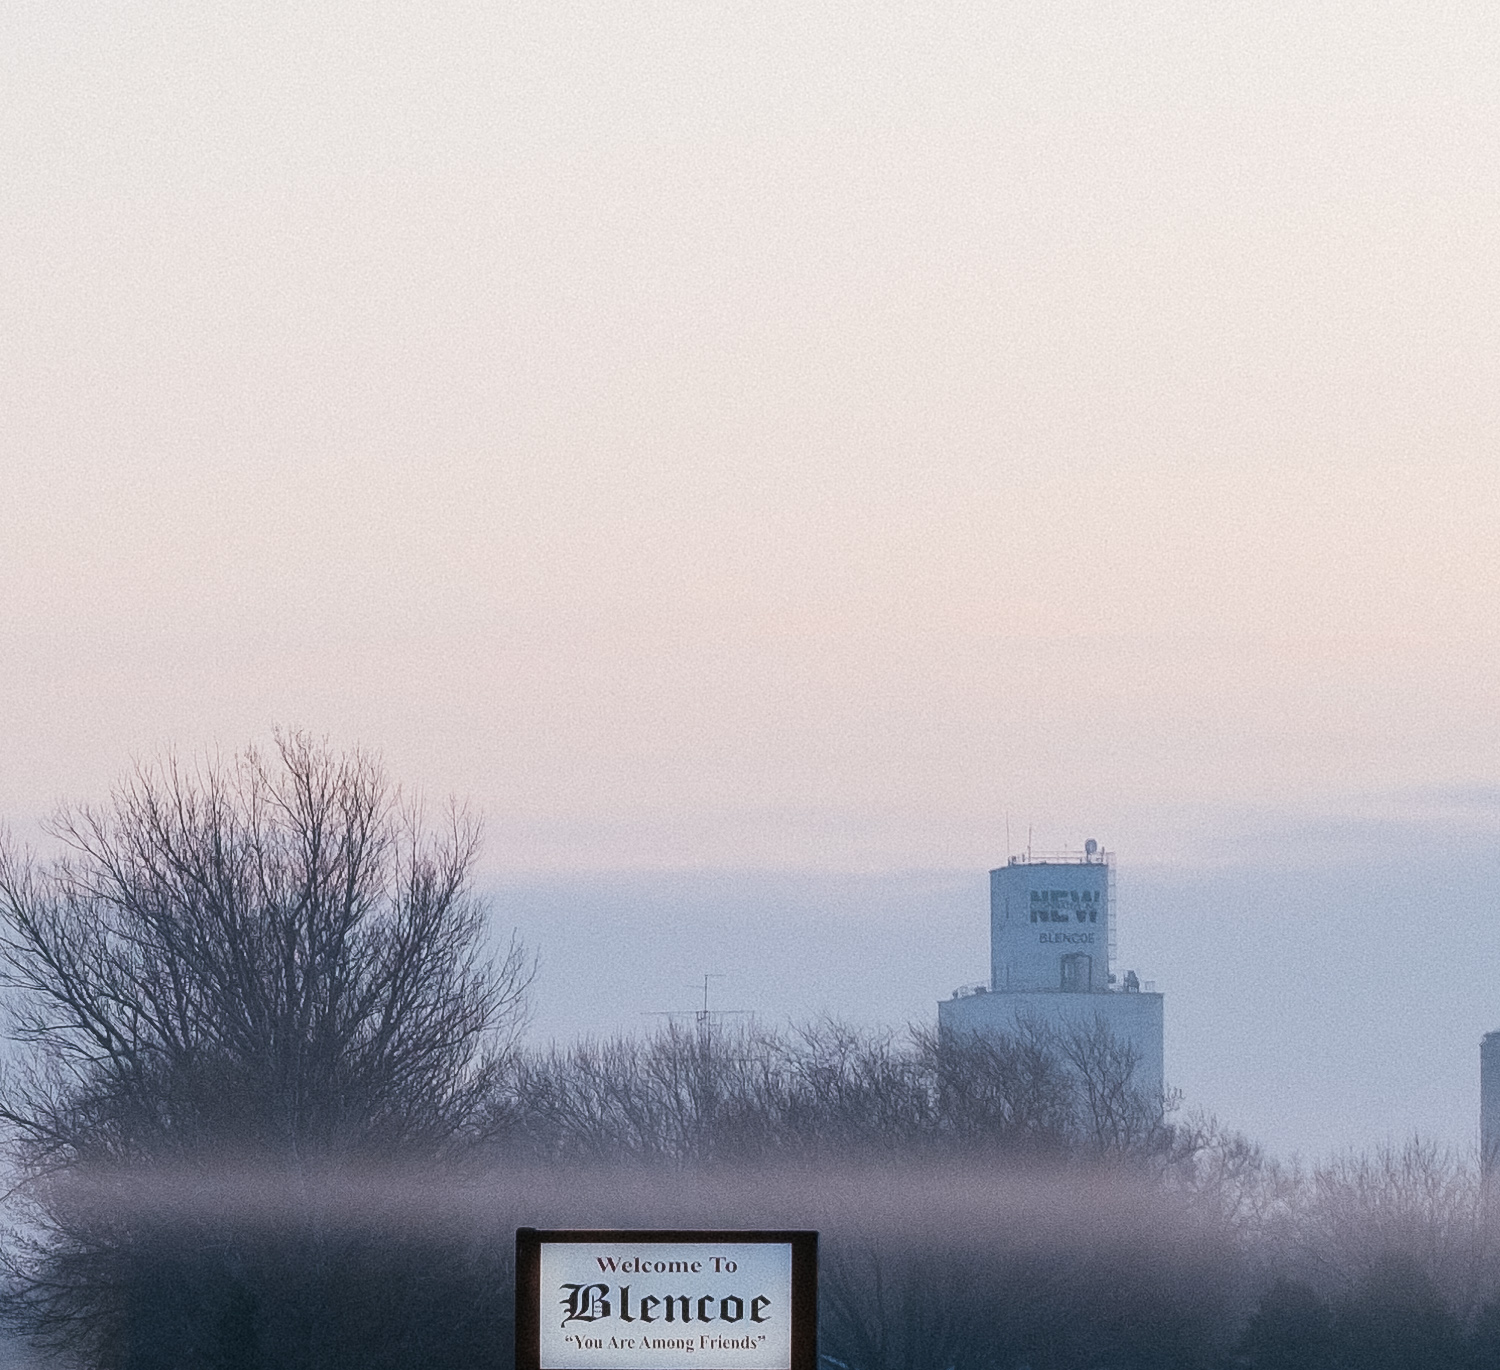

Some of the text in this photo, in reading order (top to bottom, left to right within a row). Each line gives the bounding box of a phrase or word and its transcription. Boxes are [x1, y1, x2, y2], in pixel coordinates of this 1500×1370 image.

[1030, 890, 1100, 923] NEW
[1039, 932, 1095, 944] BLENCOE
[596, 1256, 738, 1273] Welcome To
[559, 1283, 772, 1328] Blencoe
[608, 1336, 636, 1350] Are
[639, 1336, 695, 1353] Among
